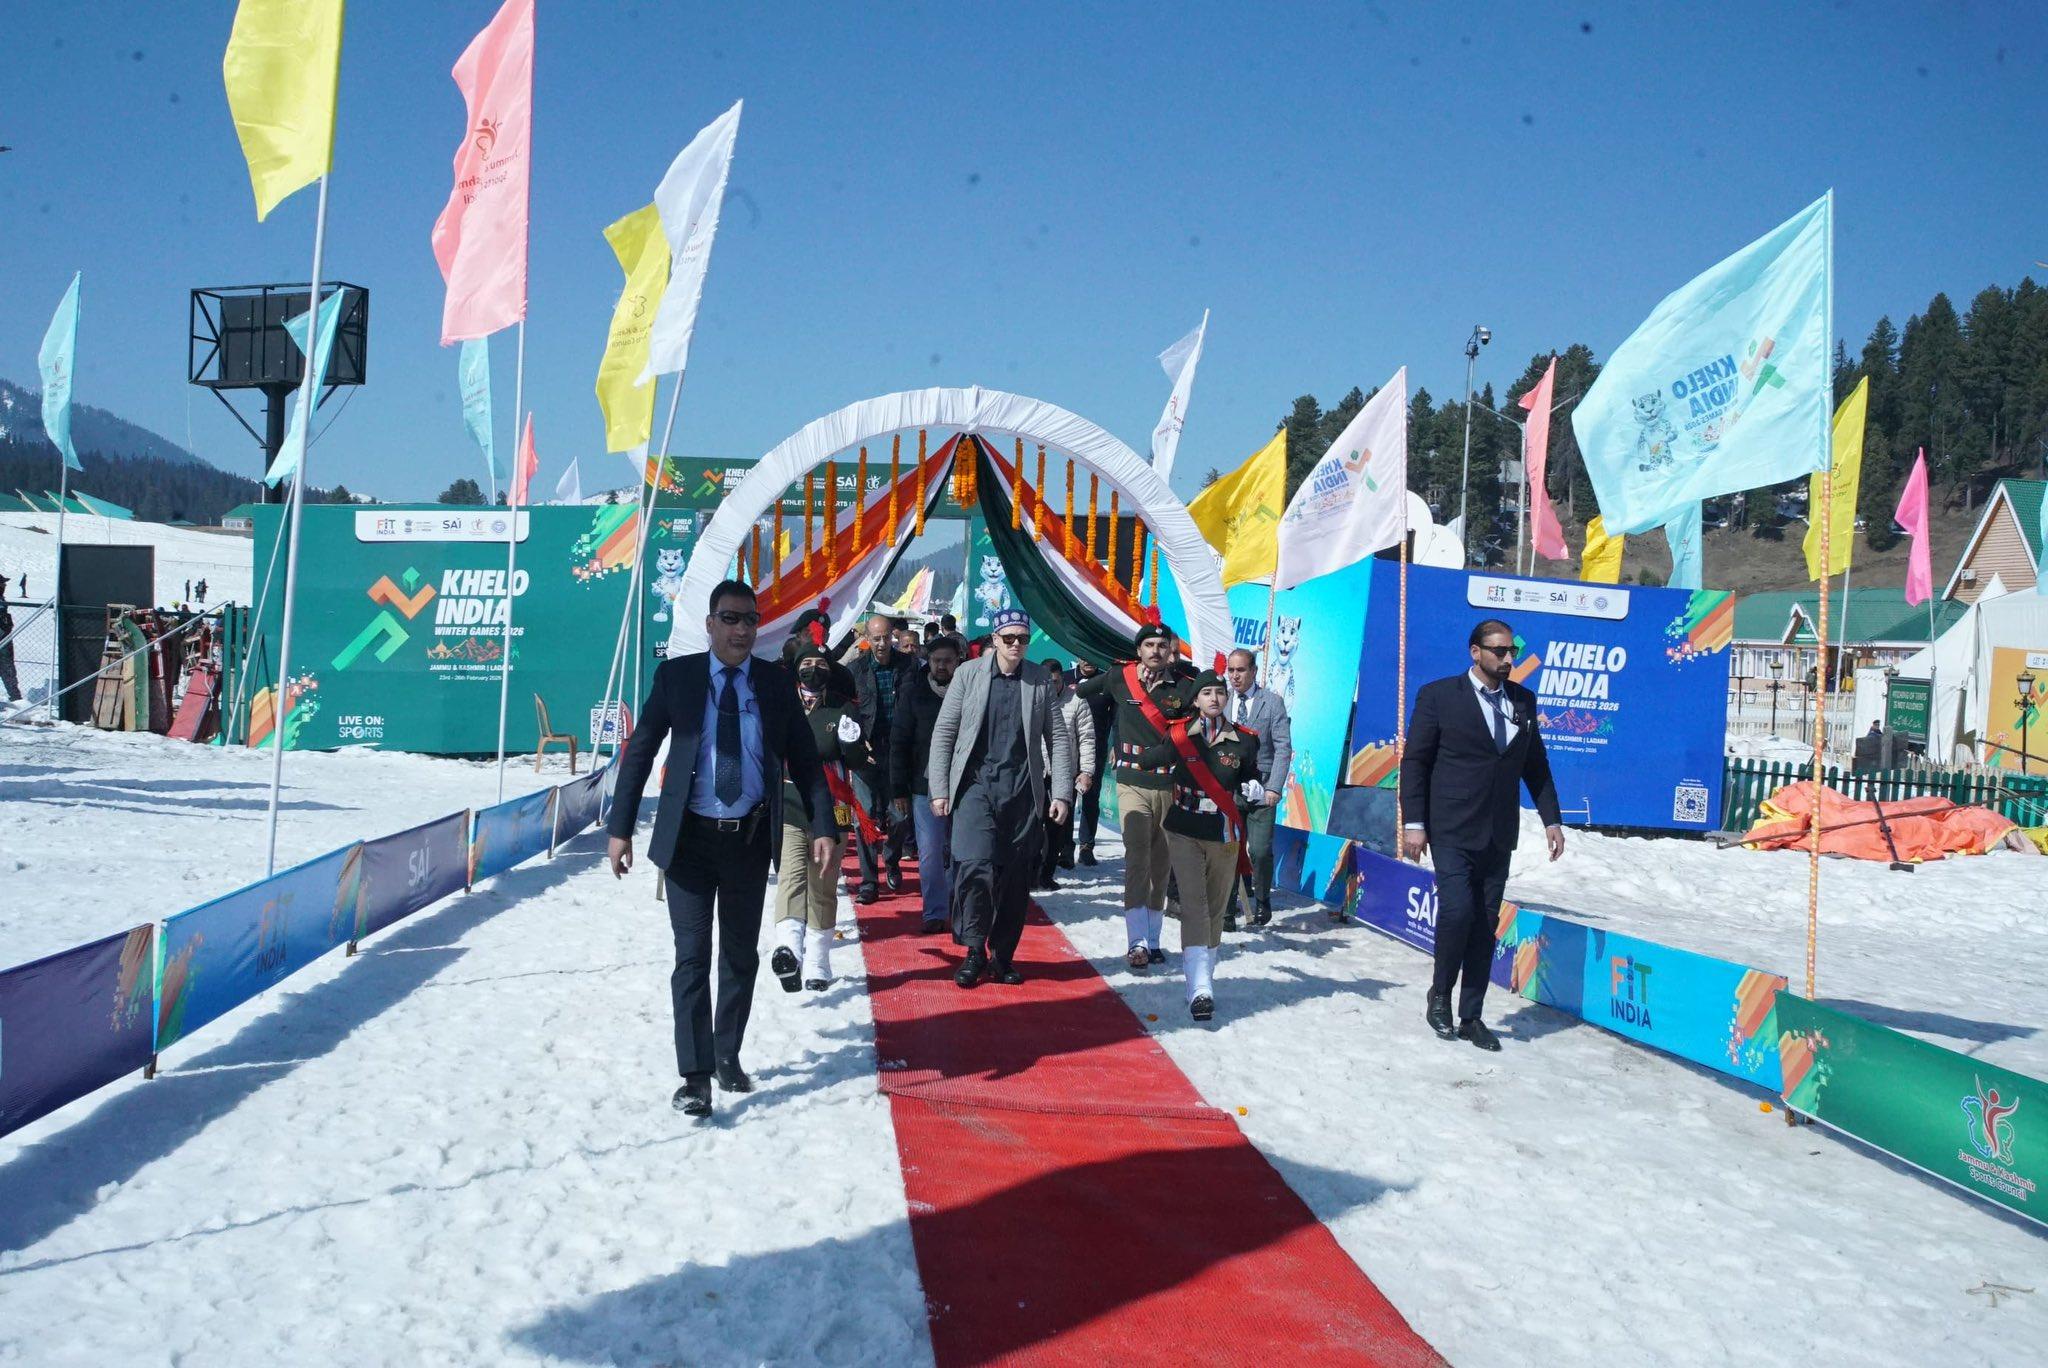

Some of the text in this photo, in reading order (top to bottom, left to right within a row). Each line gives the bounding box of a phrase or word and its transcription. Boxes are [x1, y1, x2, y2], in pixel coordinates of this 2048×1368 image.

[440, 569, 530, 597] KHELO
[434, 626, 468, 637] WINTER
[469, 627, 500, 637] GAMES
[1544, 640, 1627, 673] KHELO
[1537, 668, 1609, 700] INDIA
[1536, 696, 1620, 712] WINTER GAMES 2026
[338, 715, 385, 726] LIVE ON:
[1610, 997, 1653, 1032] INDIA
[1957, 1148, 1990, 1173] Jammu
[1997, 1165, 2036, 1193] Kashmir
[1968, 1165, 2027, 1202] Sports Council
